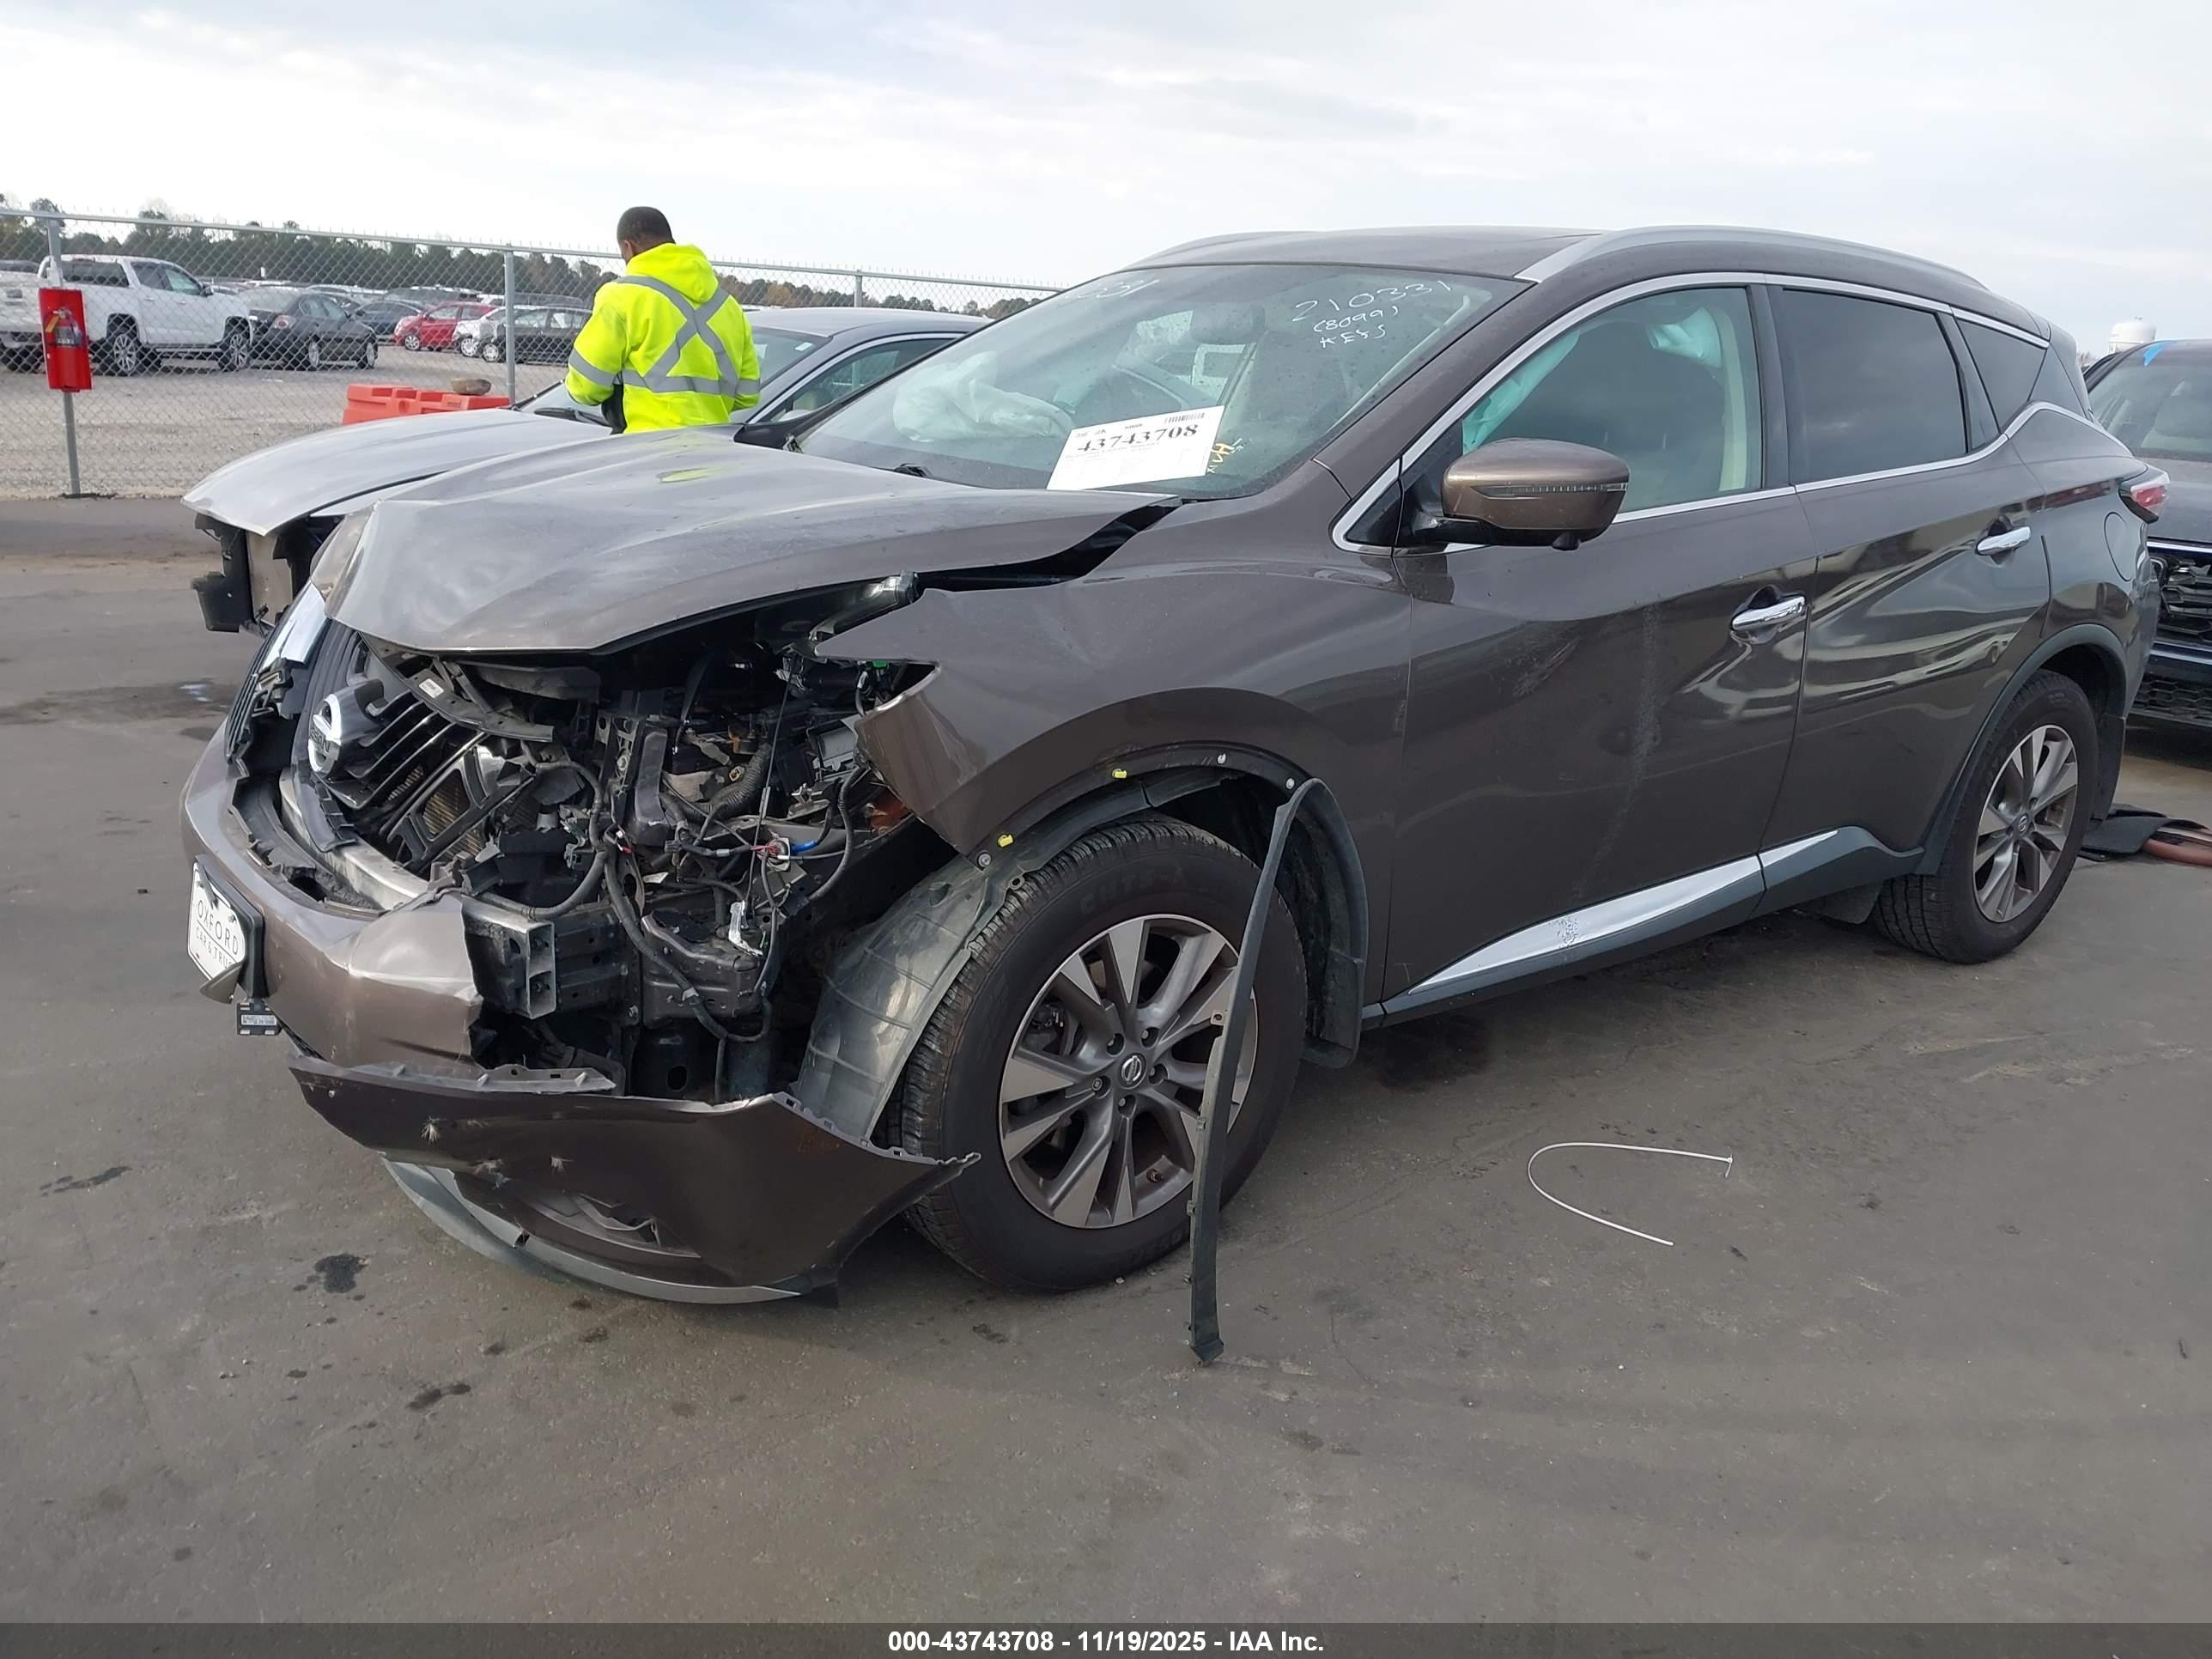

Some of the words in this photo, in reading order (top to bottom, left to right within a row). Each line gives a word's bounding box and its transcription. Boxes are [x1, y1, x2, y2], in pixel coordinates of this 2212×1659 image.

[1292, 280, 1452, 322] 210331
[1078, 423, 1199, 453] 43743708
[196, 927, 207, 949] CAR
[213, 946, 233, 969] TRU
[198, 899, 239, 956] OXFORD
